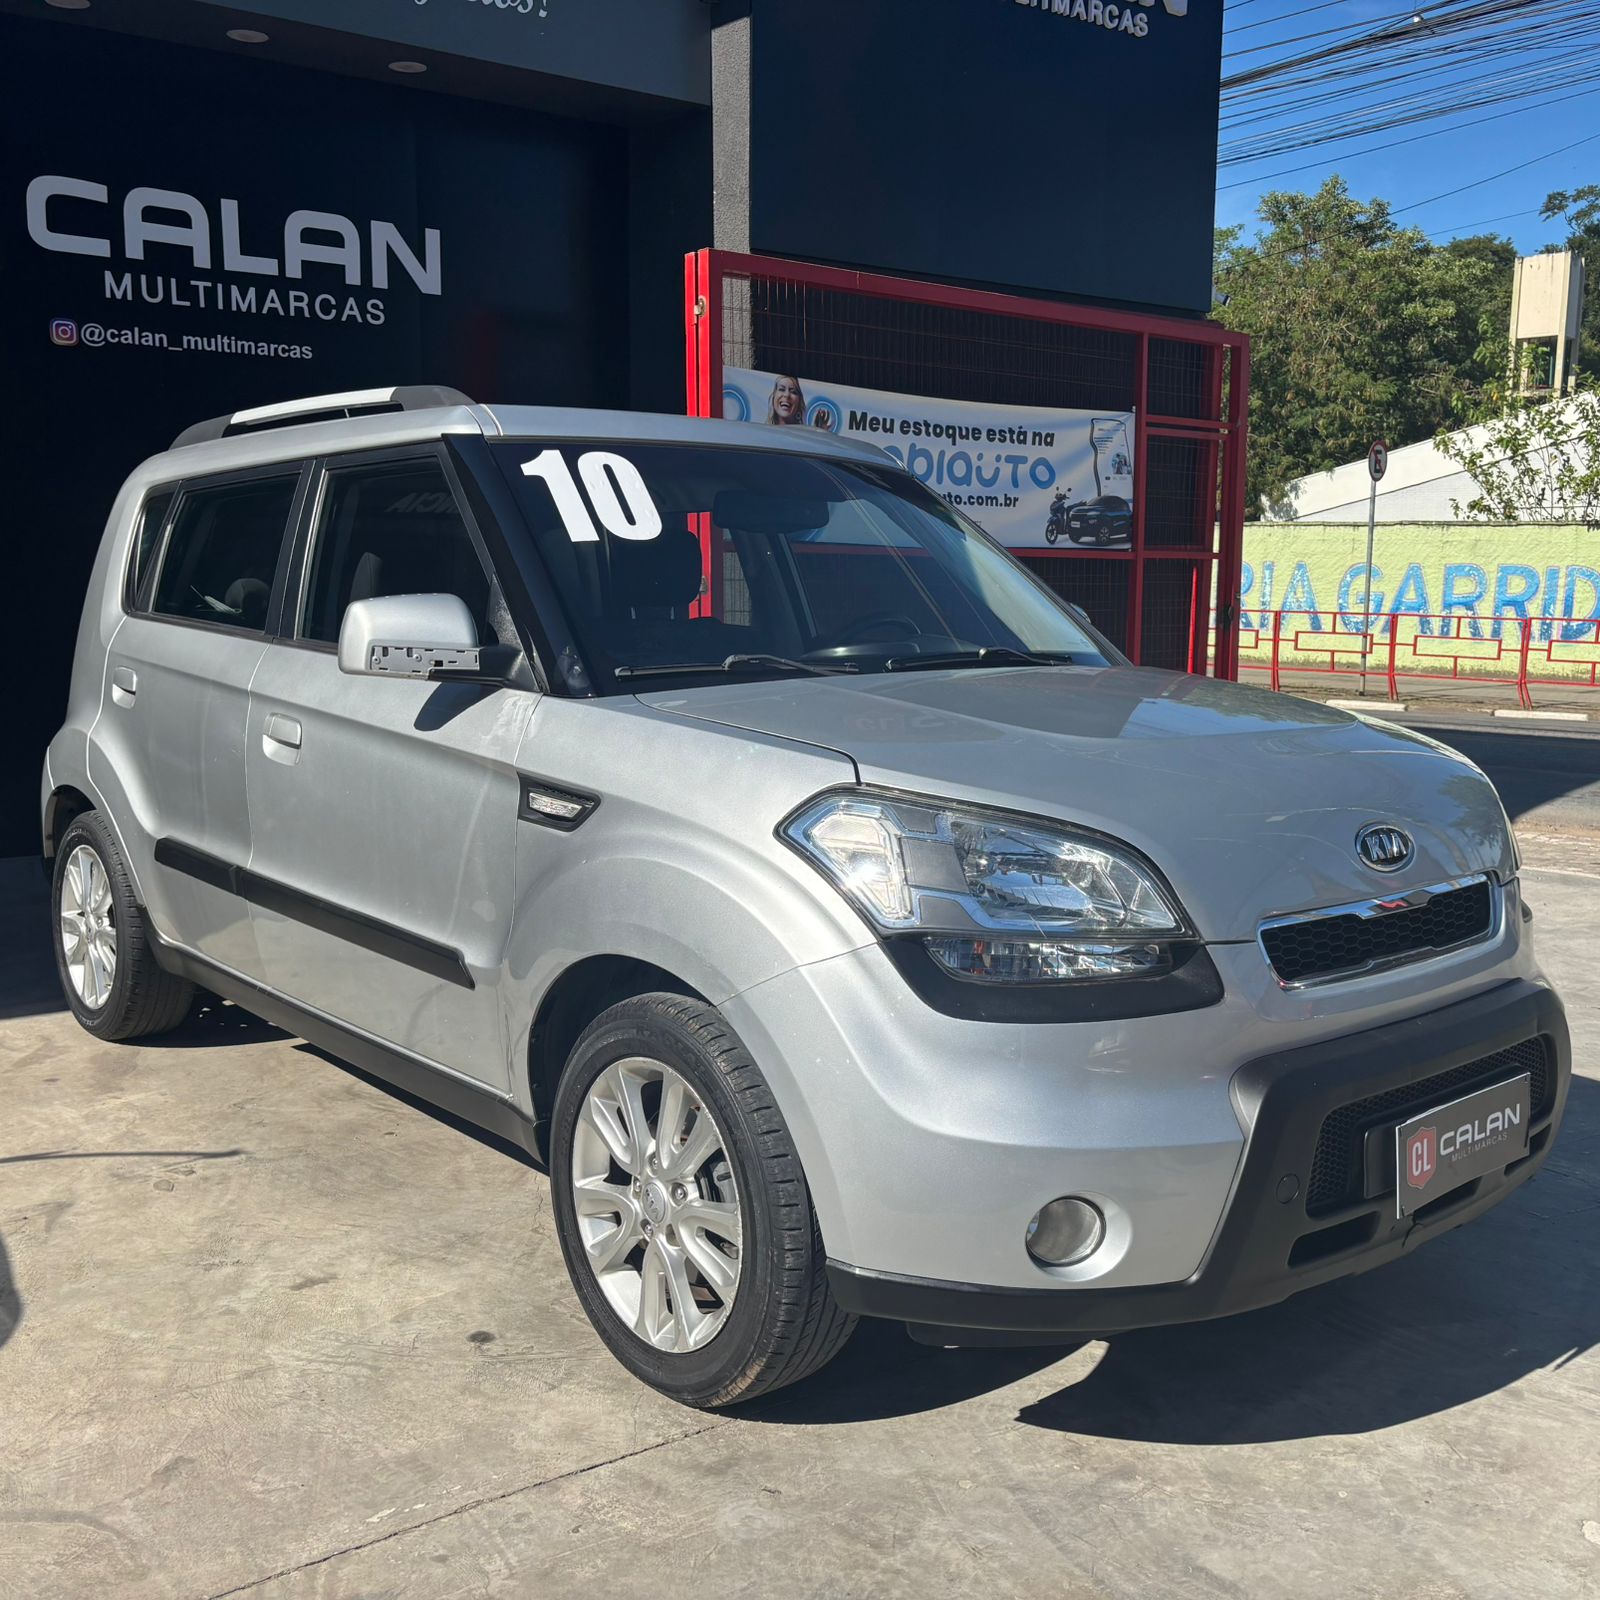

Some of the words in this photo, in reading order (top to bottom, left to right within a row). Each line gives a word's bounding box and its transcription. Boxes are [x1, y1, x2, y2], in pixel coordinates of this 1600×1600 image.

[1014, 0, 1148, 37] MARCAS
[26, 175, 442, 296] CALAN
[104, 270, 386, 325] MULTIMARCAS
[81, 323, 313, 359] @calan_multimarcas
[848, 410, 894, 434] Meu
[900, 419, 982, 446] estoque
[986, 426, 1027, 445] está
[1031, 431, 1055, 447] na
[520, 449, 662, 542] 10
[1365, 833, 1407, 861] KIA
[1440, 1103, 1520, 1156] CALAN
[1451, 1132, 1507, 1162] MULTIMARCAS
[1412, 1138, 1431, 1177] CL
